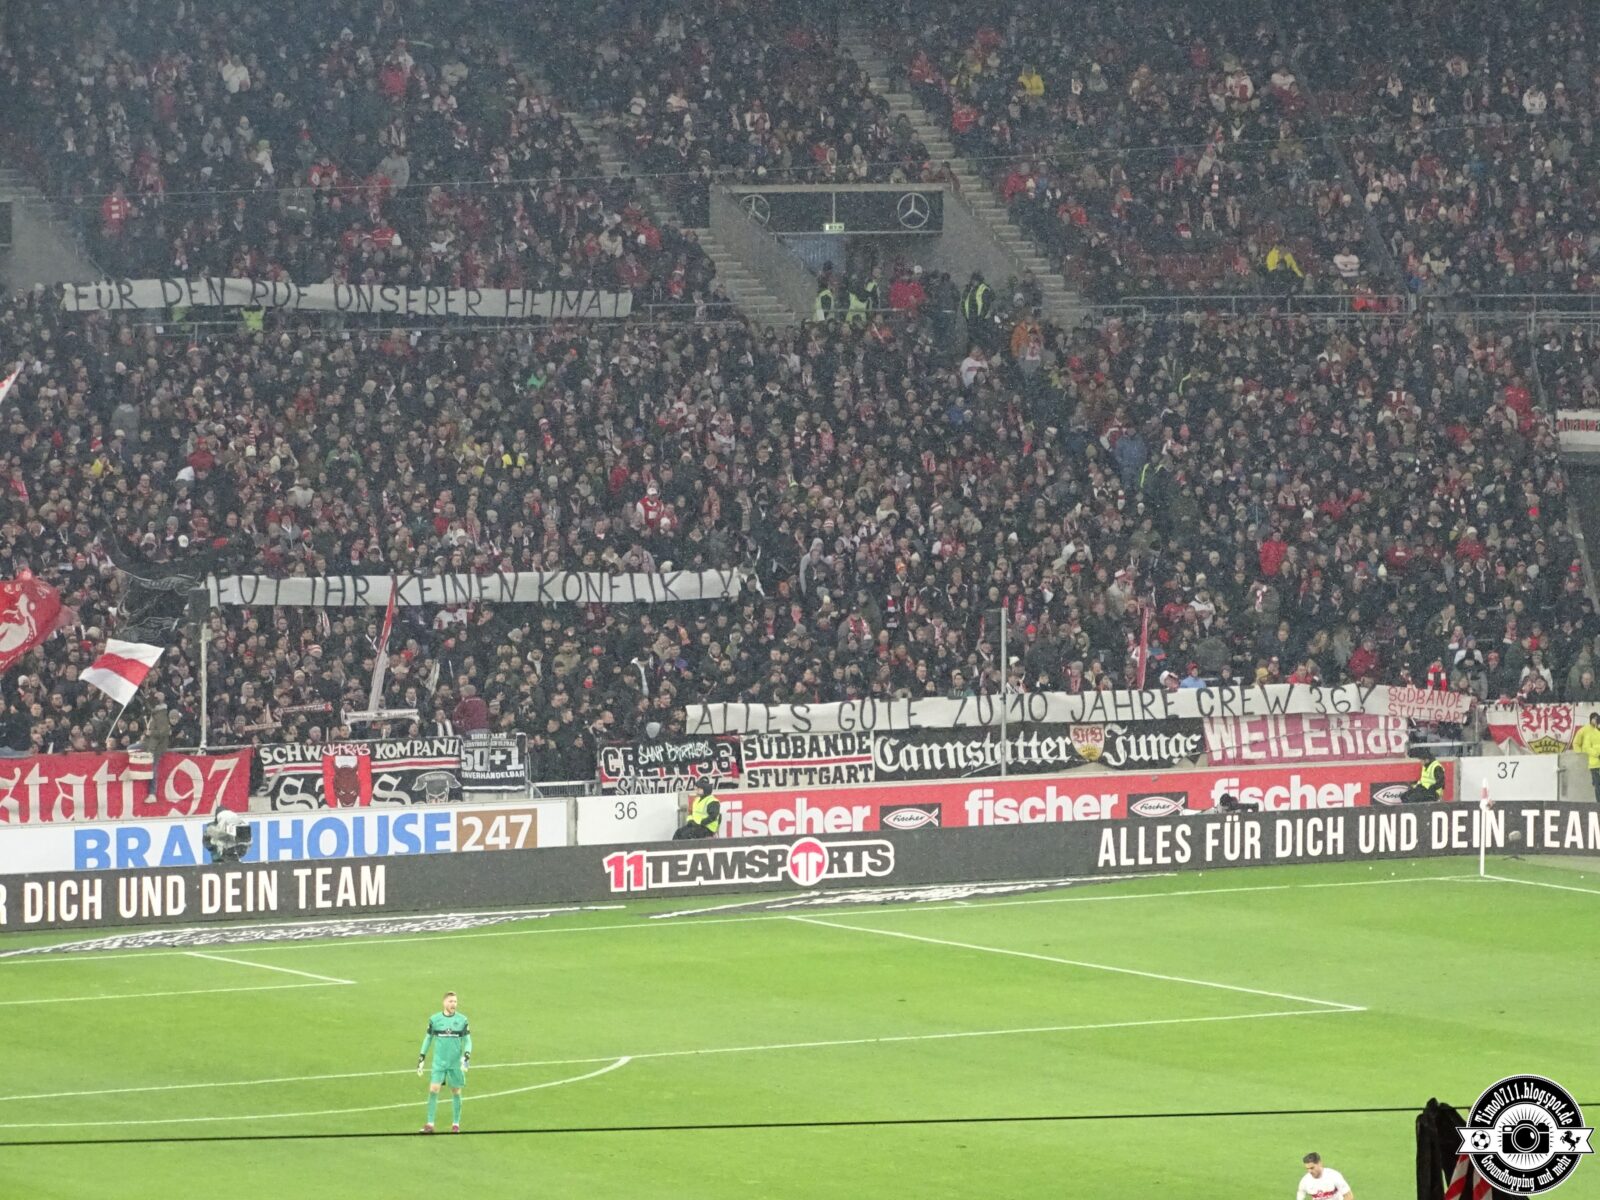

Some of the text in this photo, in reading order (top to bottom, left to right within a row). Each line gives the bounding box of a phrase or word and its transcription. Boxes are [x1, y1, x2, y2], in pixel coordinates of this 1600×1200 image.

[74, 280, 138, 310] FÜR
[161, 278, 226, 307] DEN
[333, 283, 482, 315] UNSERER
[505, 287, 631, 318] HEIMAT
[310, 575, 377, 606] IHR
[395, 571, 519, 604] KEINEN
[694, 699, 811, 734] ALLES
[838, 696, 921, 731] GUTE
[1009, 692, 1048, 723] 10
[1070, 689, 1180, 722] JAHRE
[1195, 683, 1294, 717] CREW
[322, 743, 371, 756] ULTRAS
[461, 746, 525, 771] 50+1
[743, 730, 871, 760] SÜDBANDE
[874, 730, 1072, 772] Cannstatter
[165, 757, 239, 818] 97
[747, 763, 873, 788] STUTTGART
[1498, 761, 1519, 779] 37
[614, 801, 637, 820] 36
[965, 786, 1118, 826] fischer
[1210, 775, 1361, 813] fischer
[461, 814, 532, 850] 247
[718, 797, 871, 838] fischer
[1098, 823, 1191, 867] ALLES
[1206, 815, 1261, 861] FÜR
[1276, 816, 1344, 858] DICH
[1358, 813, 1417, 853] UND
[1431, 810, 1505, 850] DEIN
[24, 879, 102, 924] DICH
[119, 875, 186, 919] UND
[202, 870, 278, 915] DEIN
[294, 865, 385, 909] TEAM
